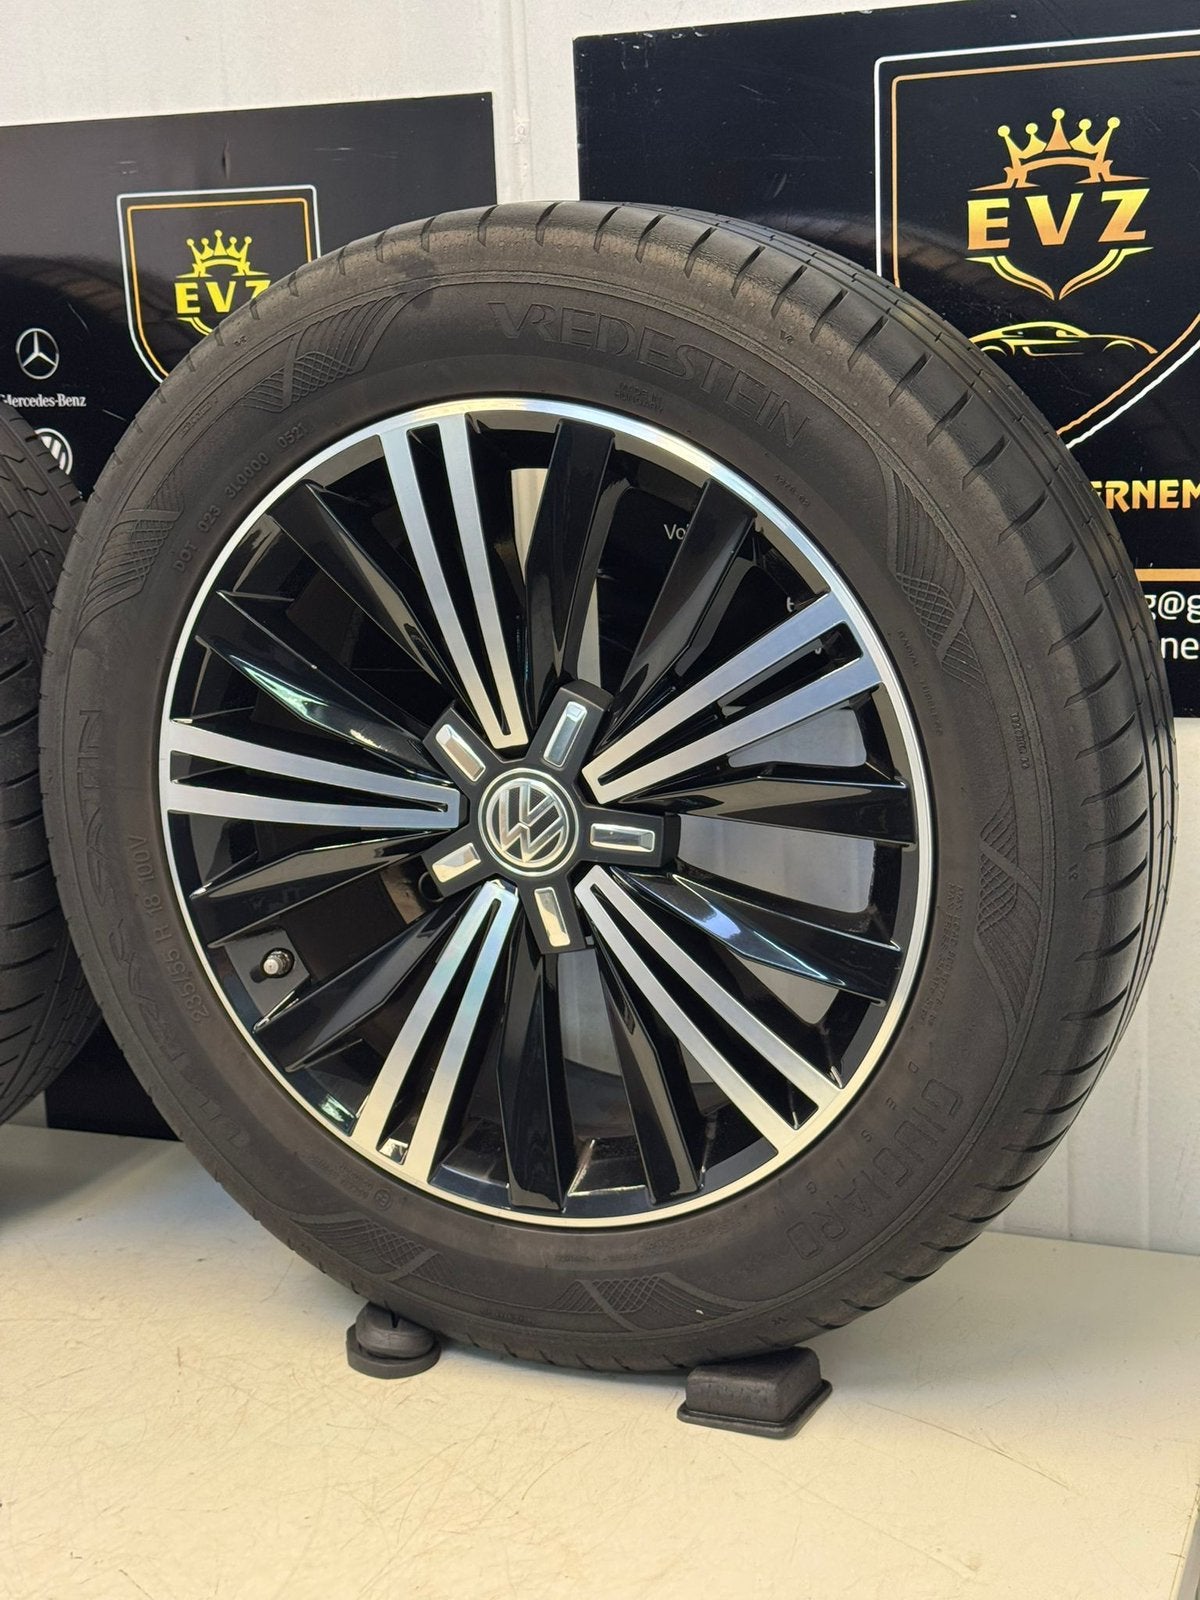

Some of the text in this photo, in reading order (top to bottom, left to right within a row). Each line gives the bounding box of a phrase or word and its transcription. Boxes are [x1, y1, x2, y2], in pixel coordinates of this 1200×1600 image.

[967, 188, 1151, 250] EVZ
[488, 301, 811, 448] VREDESTEIN
[173, 540, 197, 572] DOT
[127, 834, 210, 1025] 235/55 R 18 100V
[785, 1078, 964, 1261] GIUGIARO
